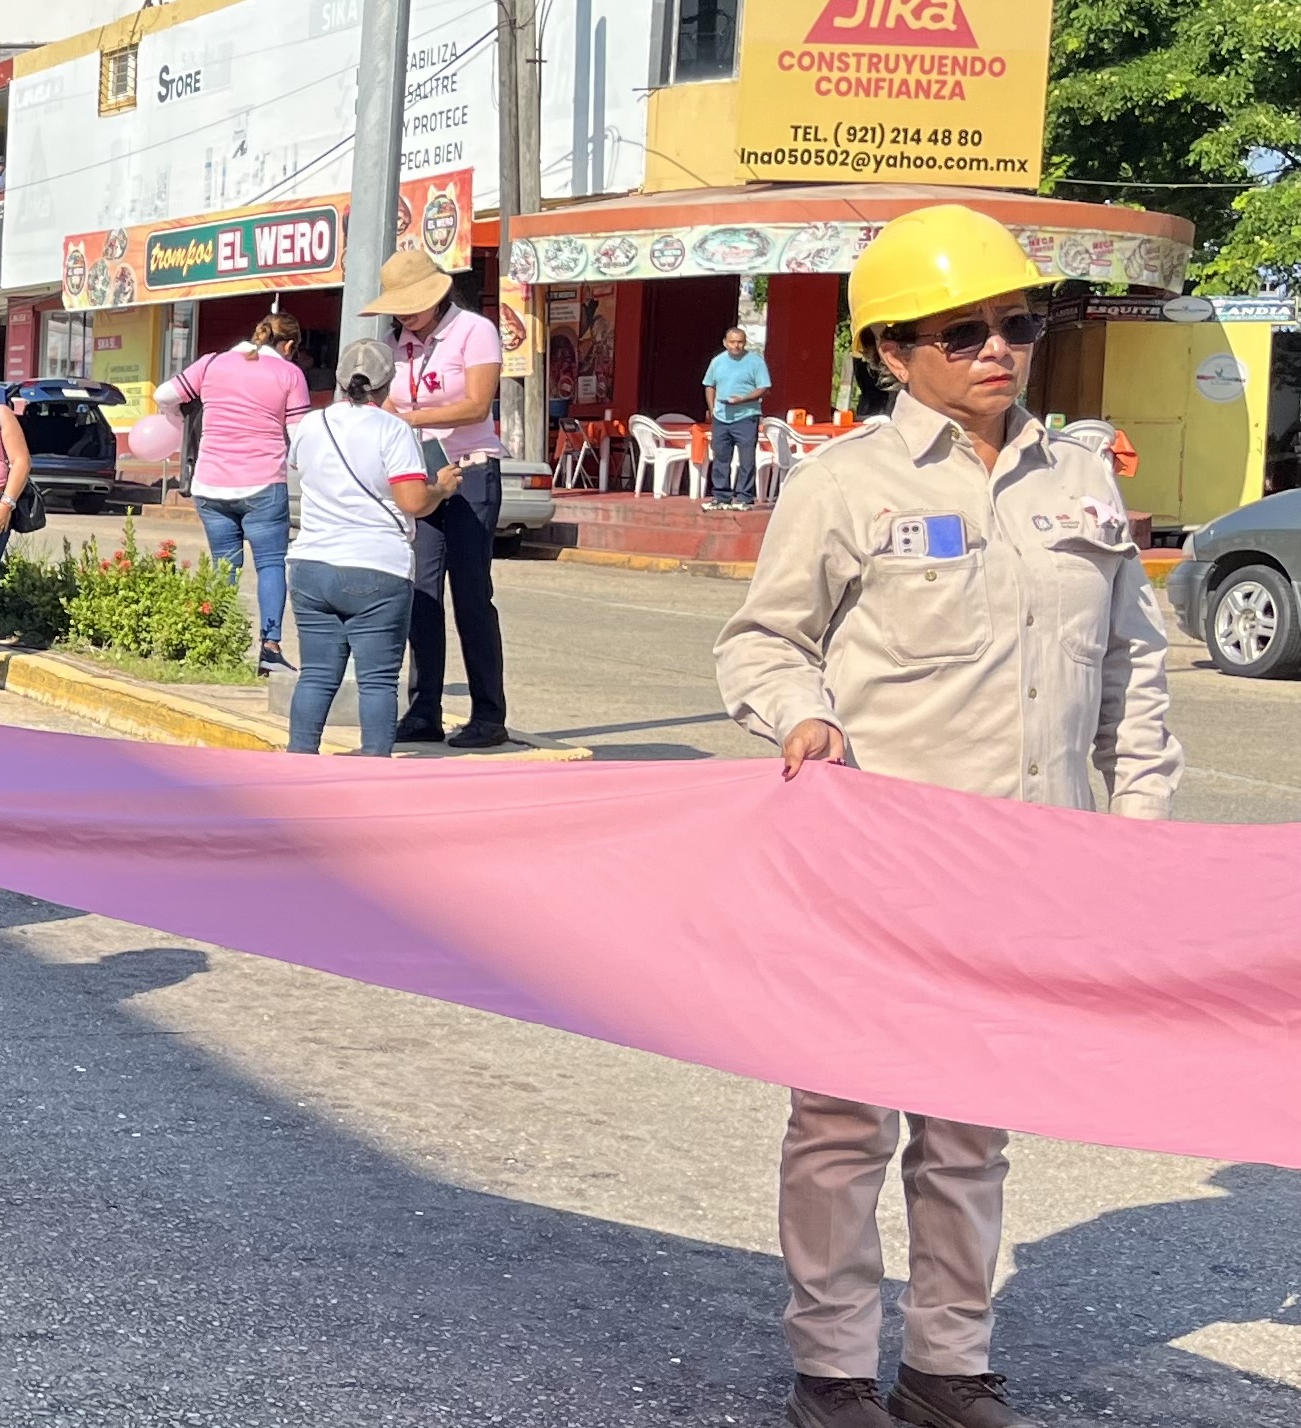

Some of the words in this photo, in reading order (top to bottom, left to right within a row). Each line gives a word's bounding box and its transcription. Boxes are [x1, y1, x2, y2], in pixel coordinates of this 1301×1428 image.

[777, 50, 1007, 77] CONSTRUYUENDO
[814, 76, 966, 101] CONFIANZA
[413, 104, 469, 137] PROTEGE
[790, 125, 828, 143] TEL.
[890, 126, 923, 146] 214
[927, 129, 953, 147] 48
[957, 130, 983, 147] 80
[434, 141, 464, 165] BIEN
[150, 238, 214, 277] trompos
[218, 230, 248, 272] EL
[254, 219, 331, 266] WERO
